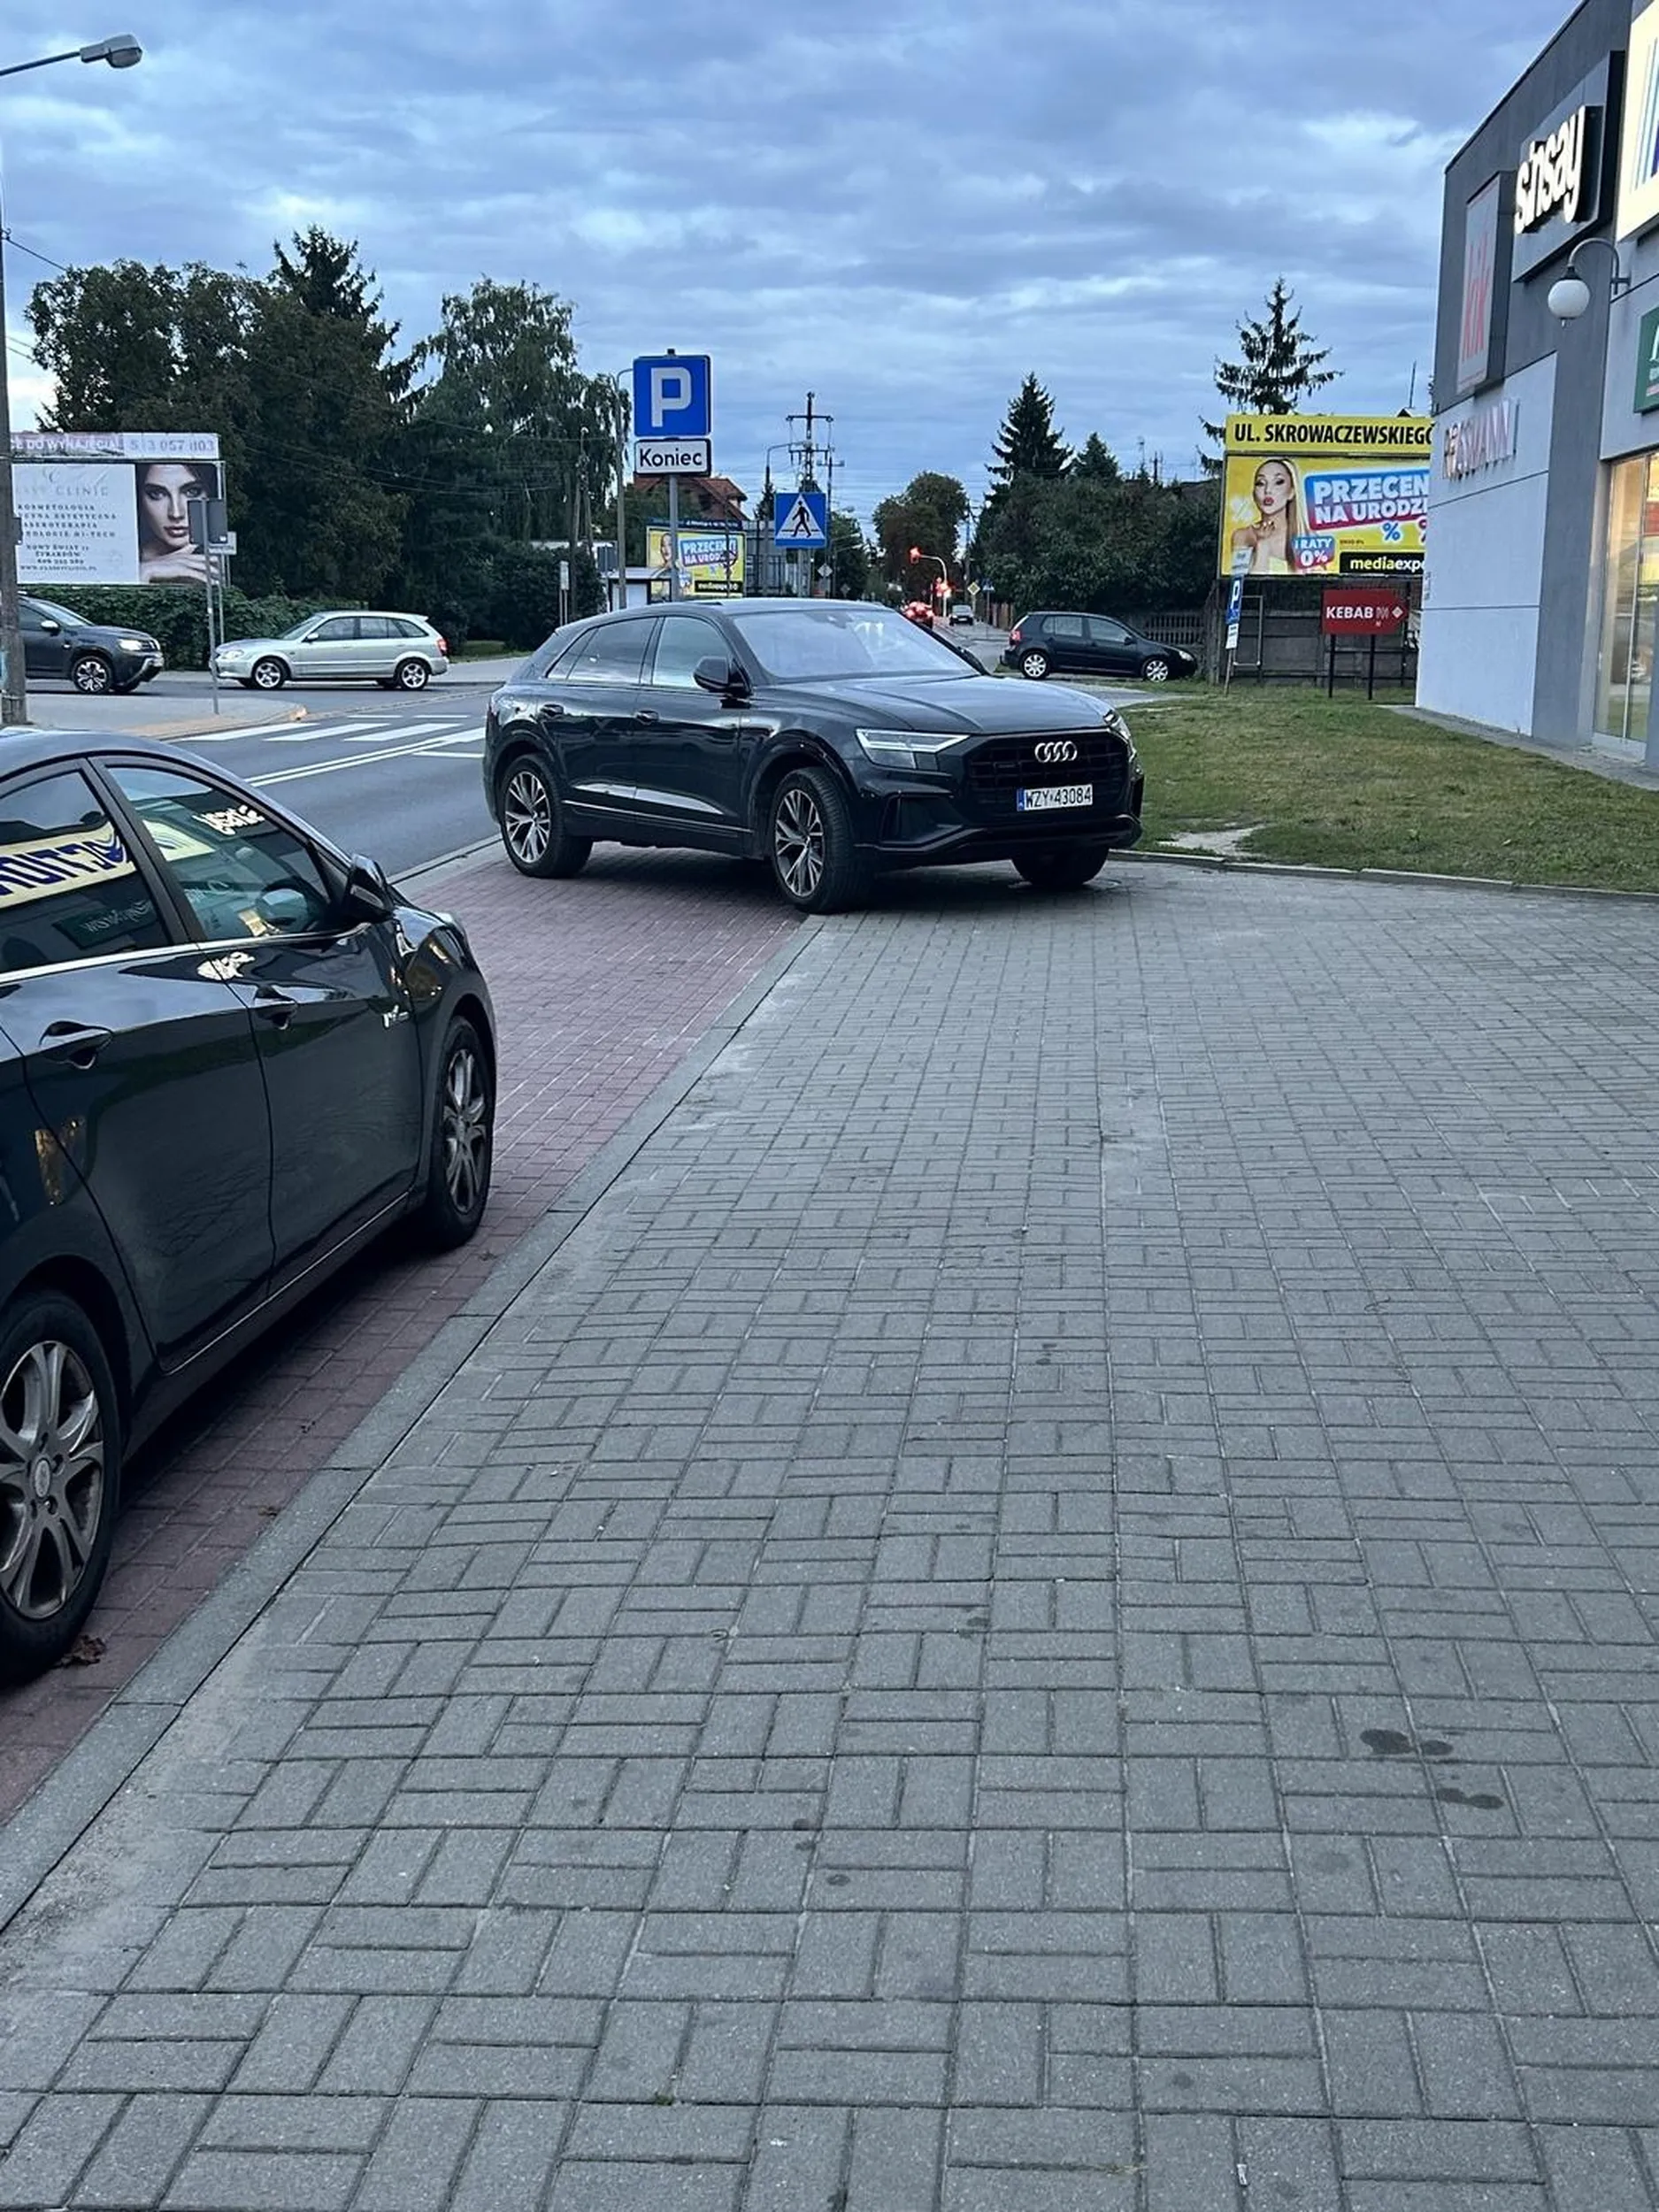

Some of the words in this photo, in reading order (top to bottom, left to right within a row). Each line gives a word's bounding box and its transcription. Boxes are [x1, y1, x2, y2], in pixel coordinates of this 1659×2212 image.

[1514, 105, 1586, 234] sinsay
[650, 366, 692, 428] P
[1235, 424, 1260, 442] UL.
[640, 448, 703, 466] Koniec
[1313, 474, 1429, 504] PRZECEN
[1315, 504, 1348, 524] NA
[1300, 537, 1333, 549] RATY
[1300, 549, 1328, 567] 0%
[1231, 580, 1240, 610] P
[1326, 606, 1373, 619] KEBAB
[1054, 787, 1092, 805] 43084
